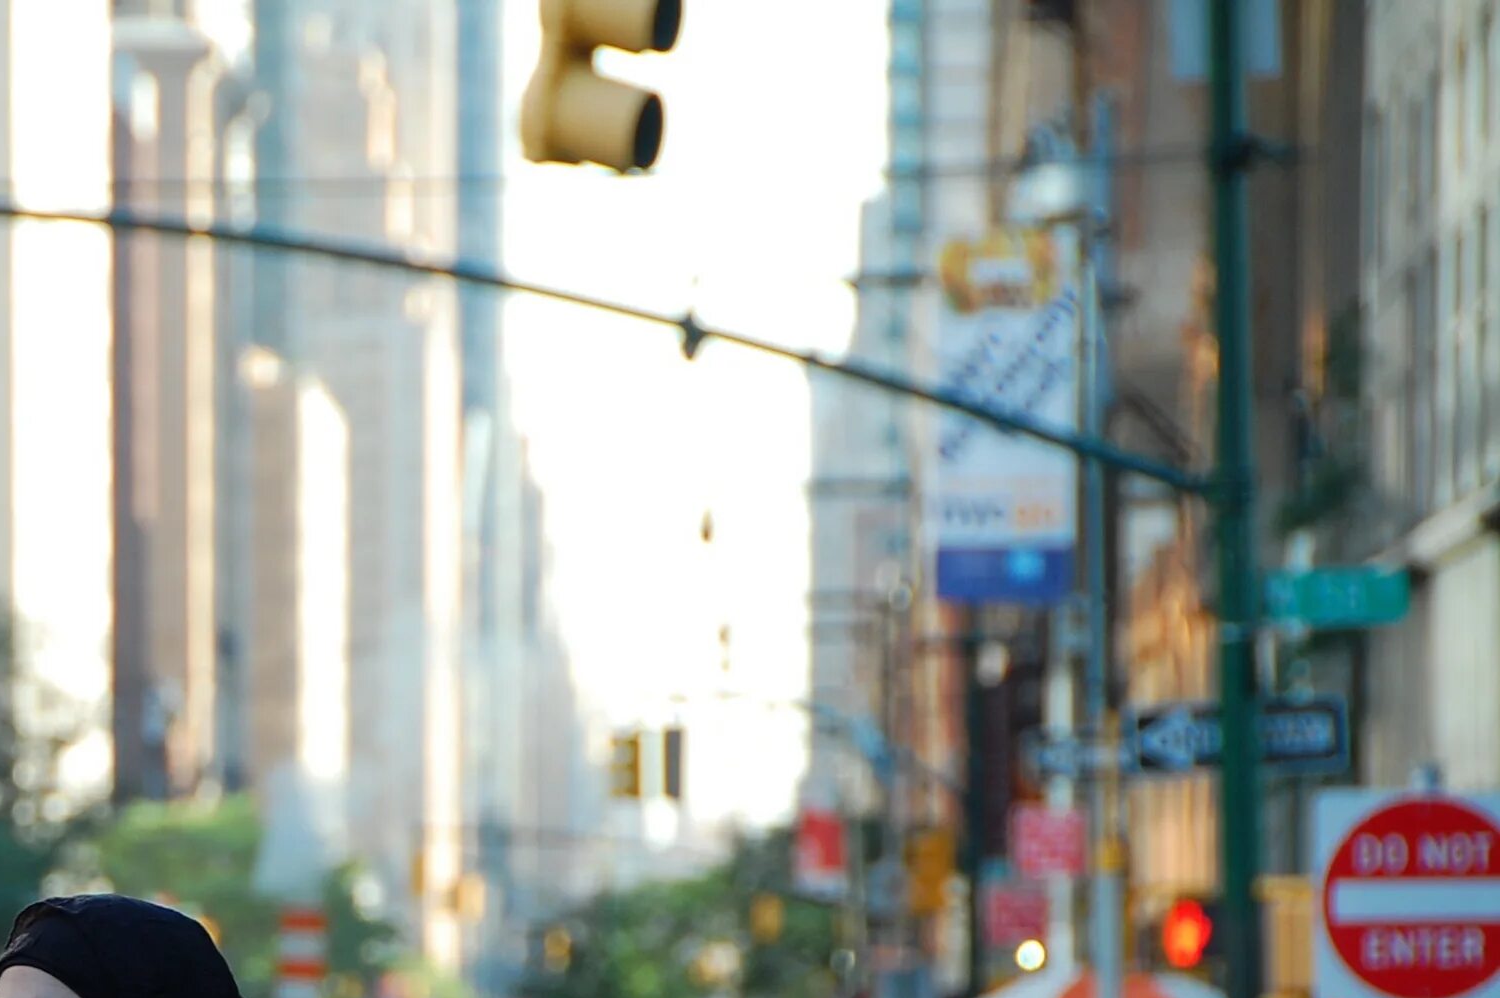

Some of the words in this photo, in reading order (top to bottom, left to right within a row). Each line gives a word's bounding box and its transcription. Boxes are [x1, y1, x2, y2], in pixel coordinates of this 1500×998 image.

[1354, 832, 1409, 876] DO
[1418, 831, 1492, 874] NOT
[1361, 925, 1486, 971] ENTER
